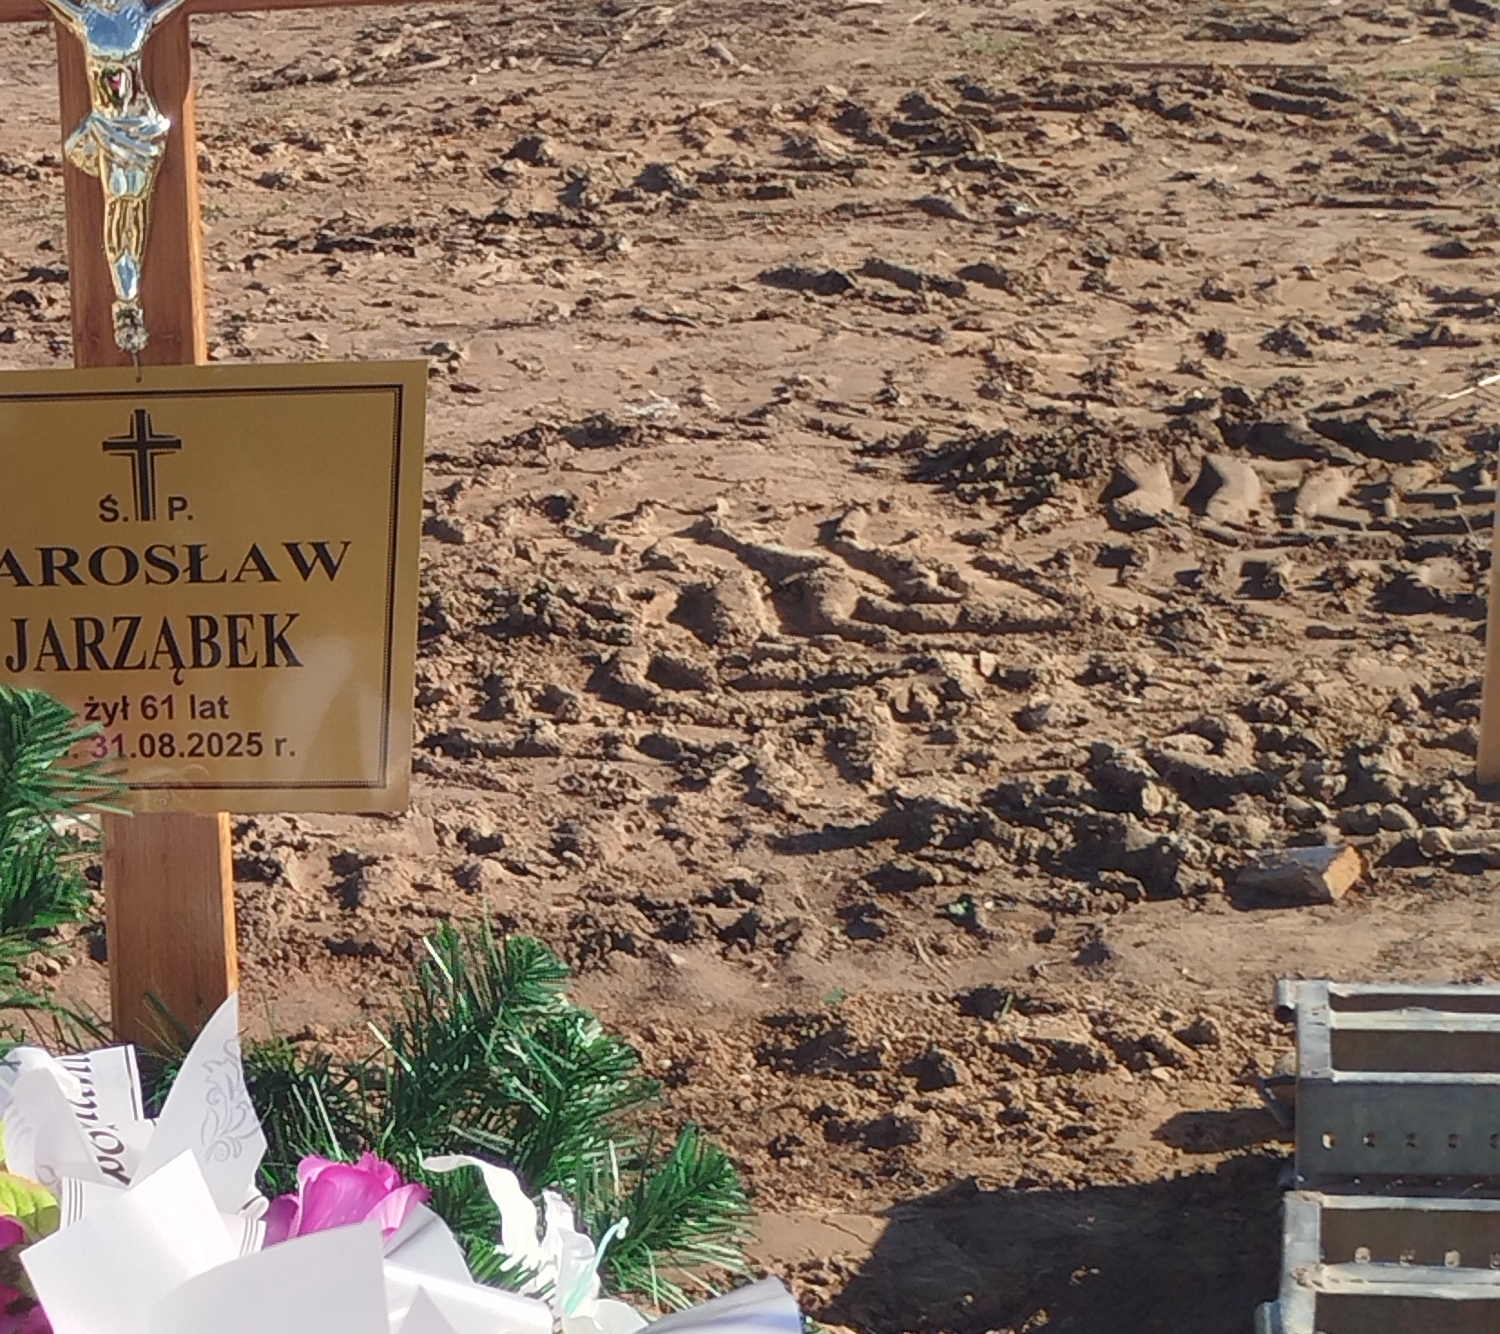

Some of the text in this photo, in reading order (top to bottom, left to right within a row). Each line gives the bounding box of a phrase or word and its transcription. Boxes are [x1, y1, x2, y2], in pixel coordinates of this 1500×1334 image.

[99, 493, 194, 523] Ś. P.
[5, 611, 304, 685] JARZĄBEK
[84, 693, 230, 727] żył 61 lat
[90, 731, 264, 760] 31.08.2025
[274, 737, 297, 758] r.
